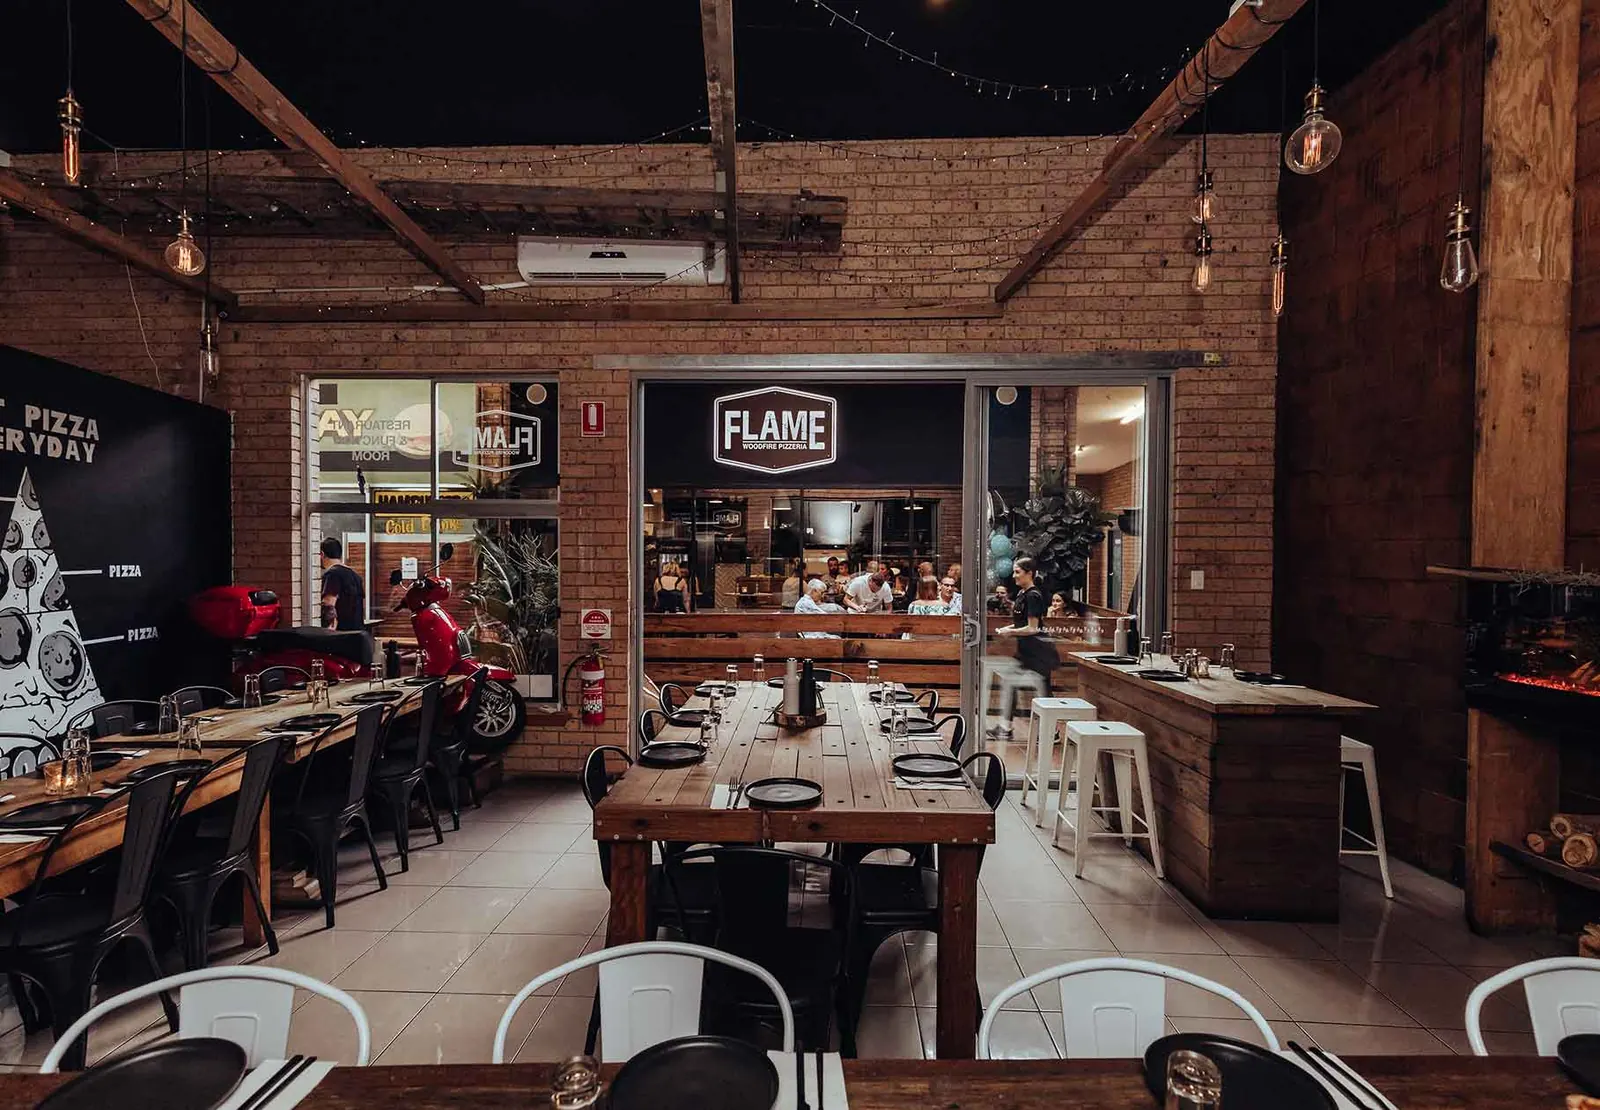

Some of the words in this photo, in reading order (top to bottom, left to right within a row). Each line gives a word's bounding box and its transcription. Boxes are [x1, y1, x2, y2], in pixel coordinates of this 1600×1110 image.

[25, 404, 99, 441] PIZZA
[724, 410, 826, 450] FLAME
[385, 519, 415, 535] Cold
[109, 565, 142, 578] PIZZA
[127, 626, 159, 642] PIZZA
